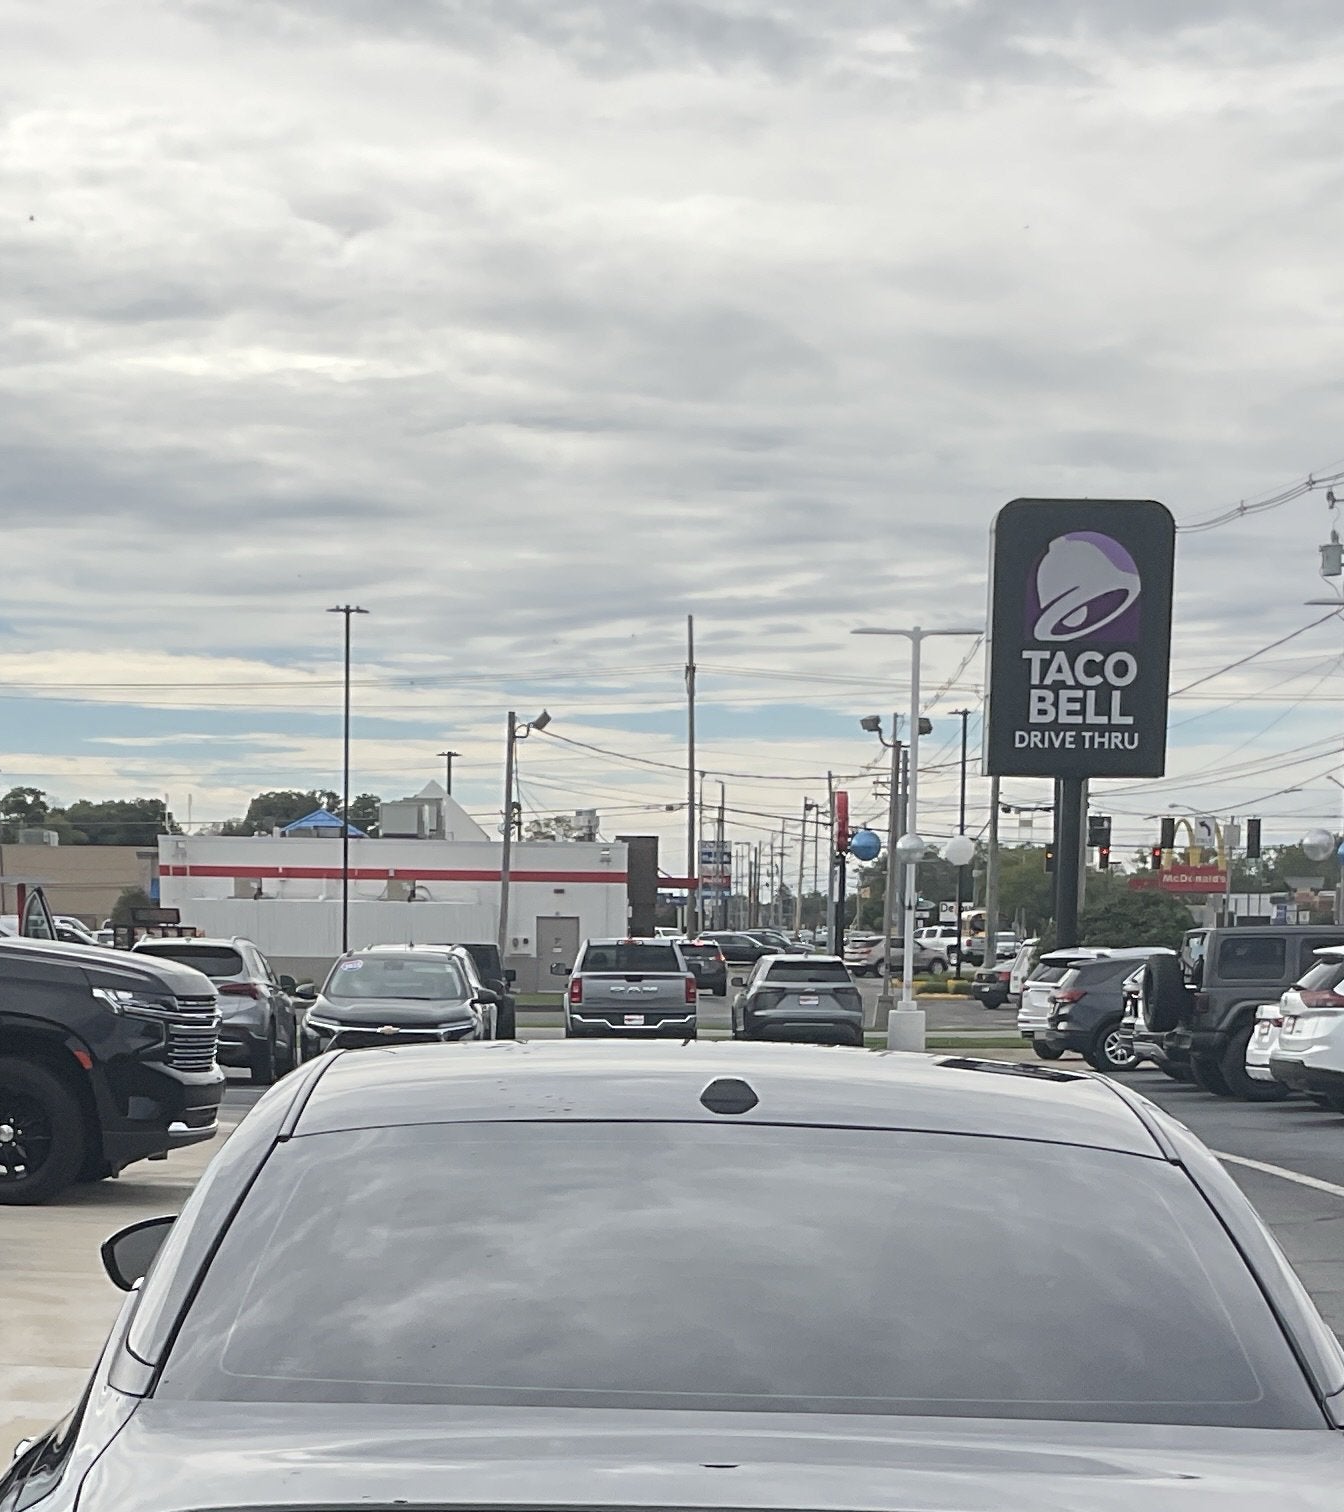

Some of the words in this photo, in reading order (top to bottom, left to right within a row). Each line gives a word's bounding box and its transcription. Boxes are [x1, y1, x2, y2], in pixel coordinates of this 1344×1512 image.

[1022, 650, 1138, 686] TACO
[1029, 689, 1134, 724] BELL
[1015, 731, 1076, 748] DRIVE
[1081, 732, 1139, 749] THRU
